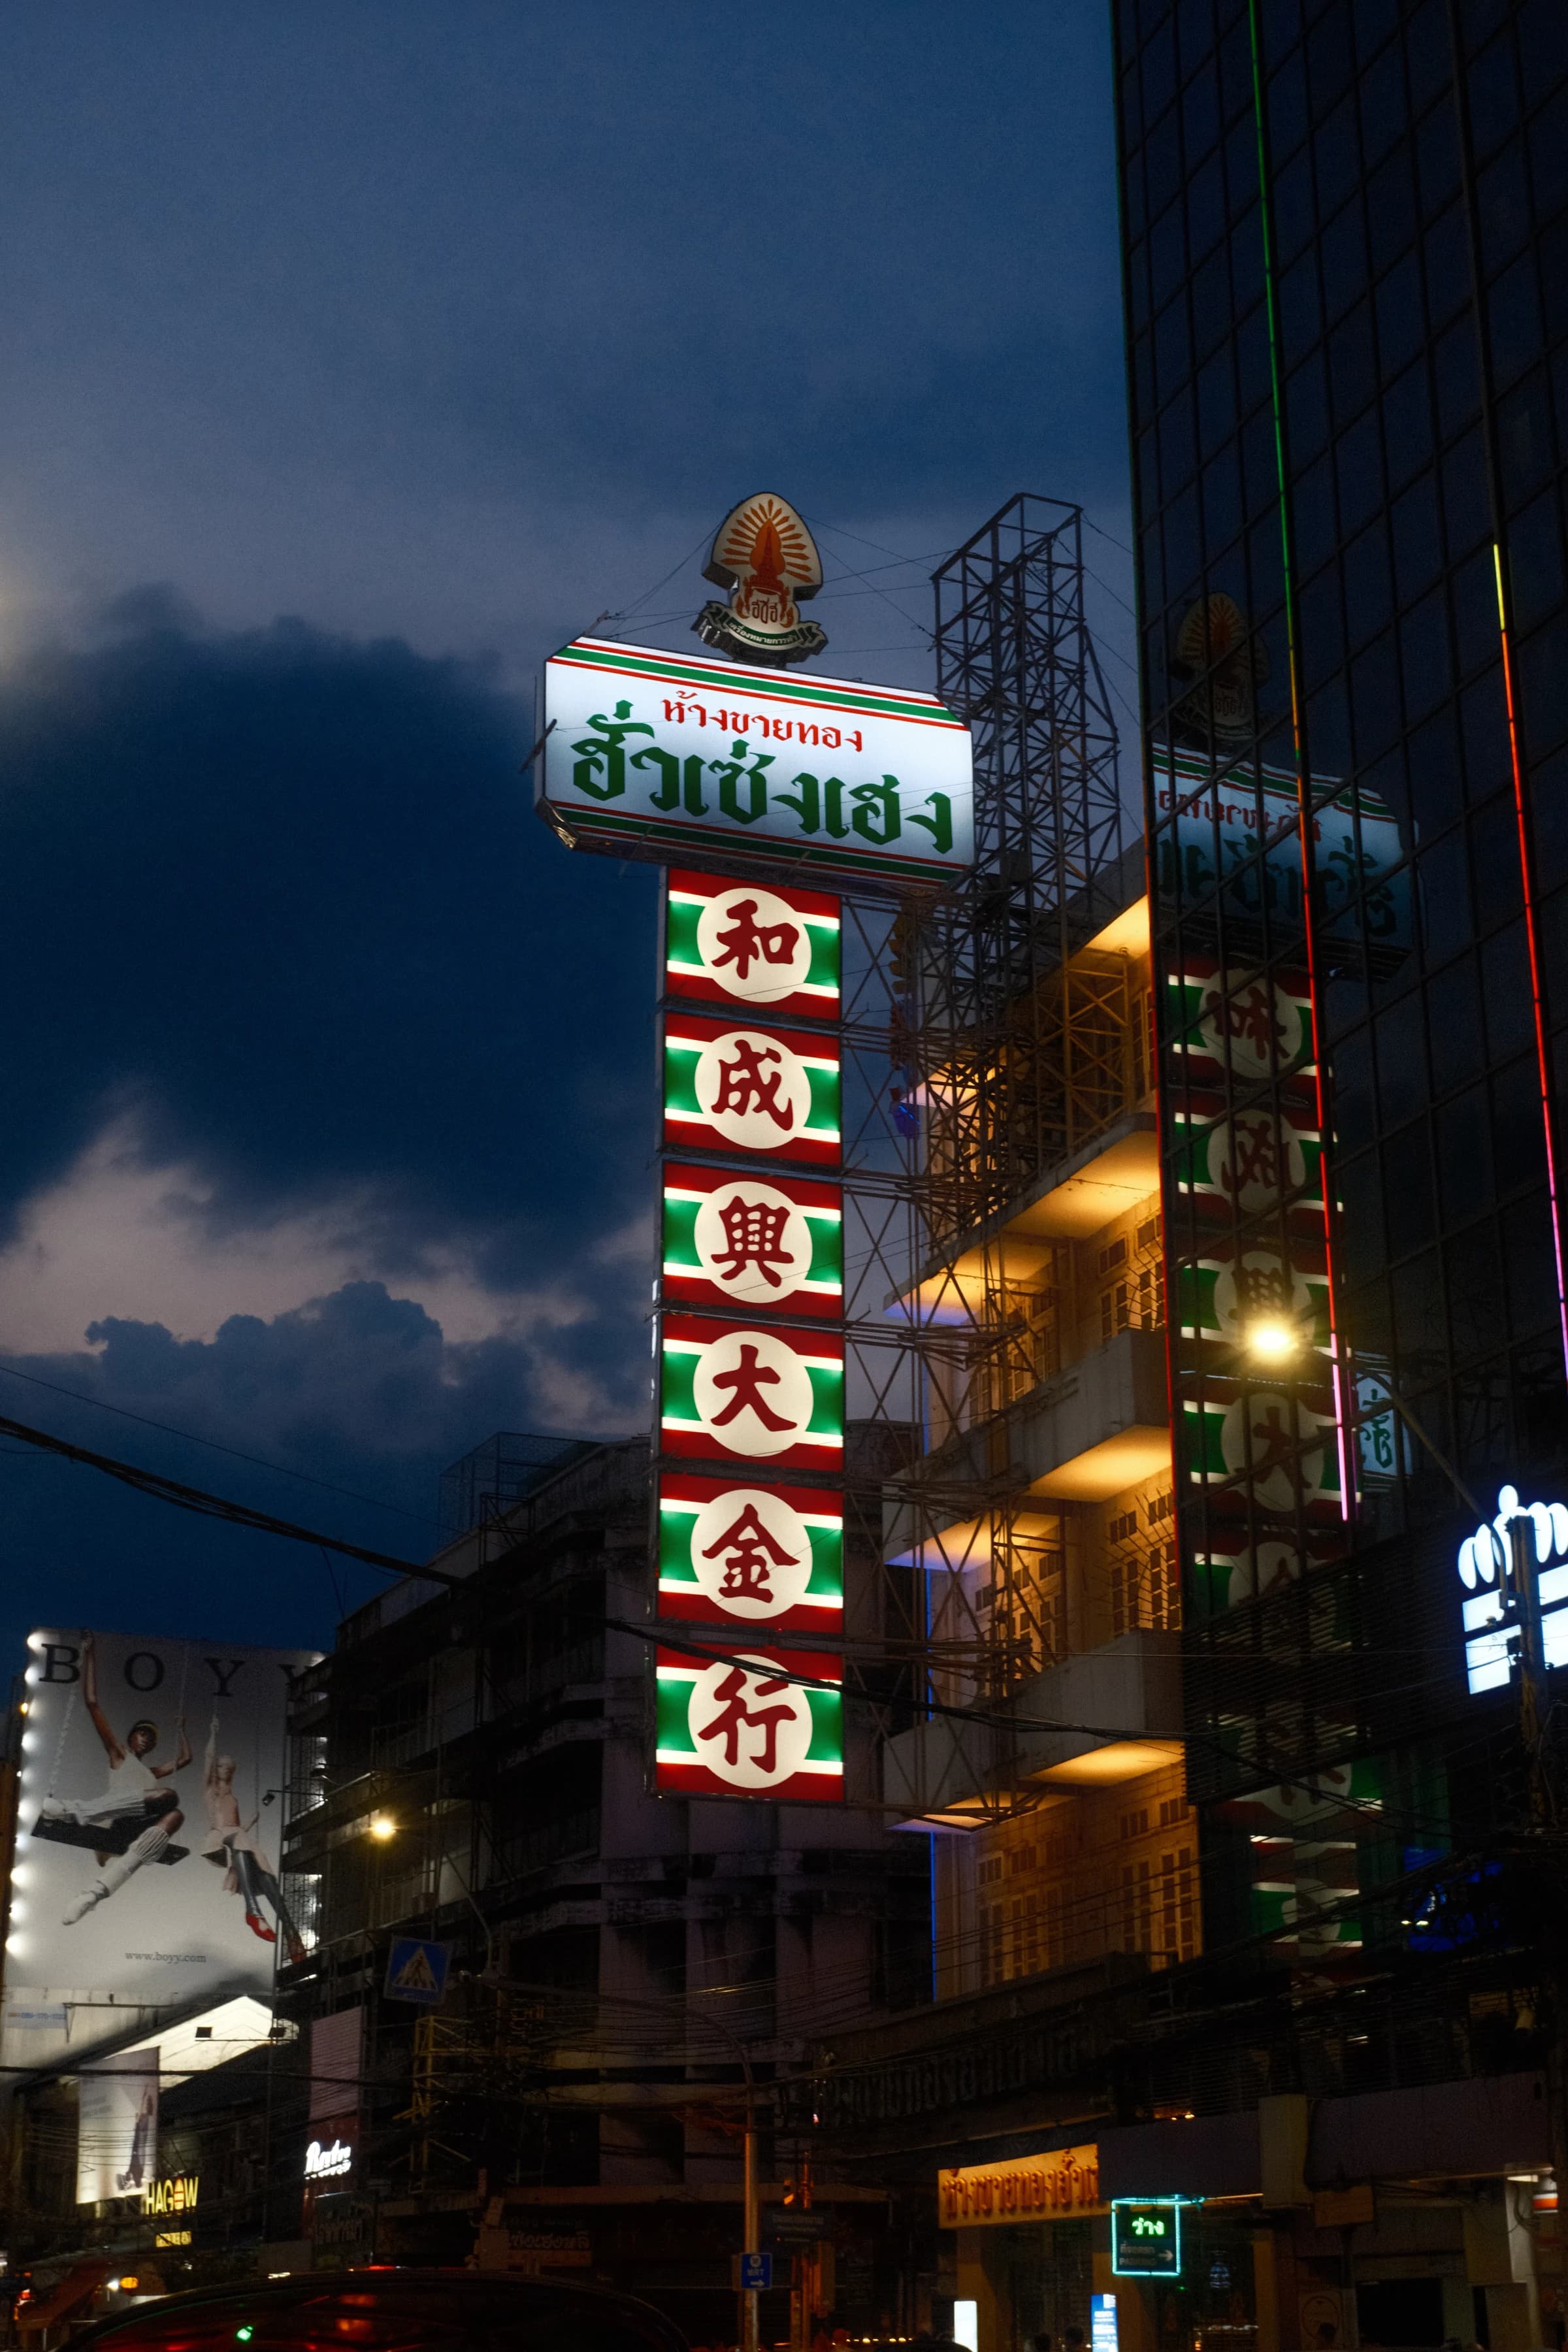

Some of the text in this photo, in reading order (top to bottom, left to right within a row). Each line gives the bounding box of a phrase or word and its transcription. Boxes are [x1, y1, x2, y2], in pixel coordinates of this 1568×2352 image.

[662, 690, 863, 753] ห้างขายทอง
[570, 699, 953, 855] ฮั่วเซ่งเฮง
[698, 899, 801, 1773] 和成興大金行
[125, 1952, 206, 1964] www.boyy.com
